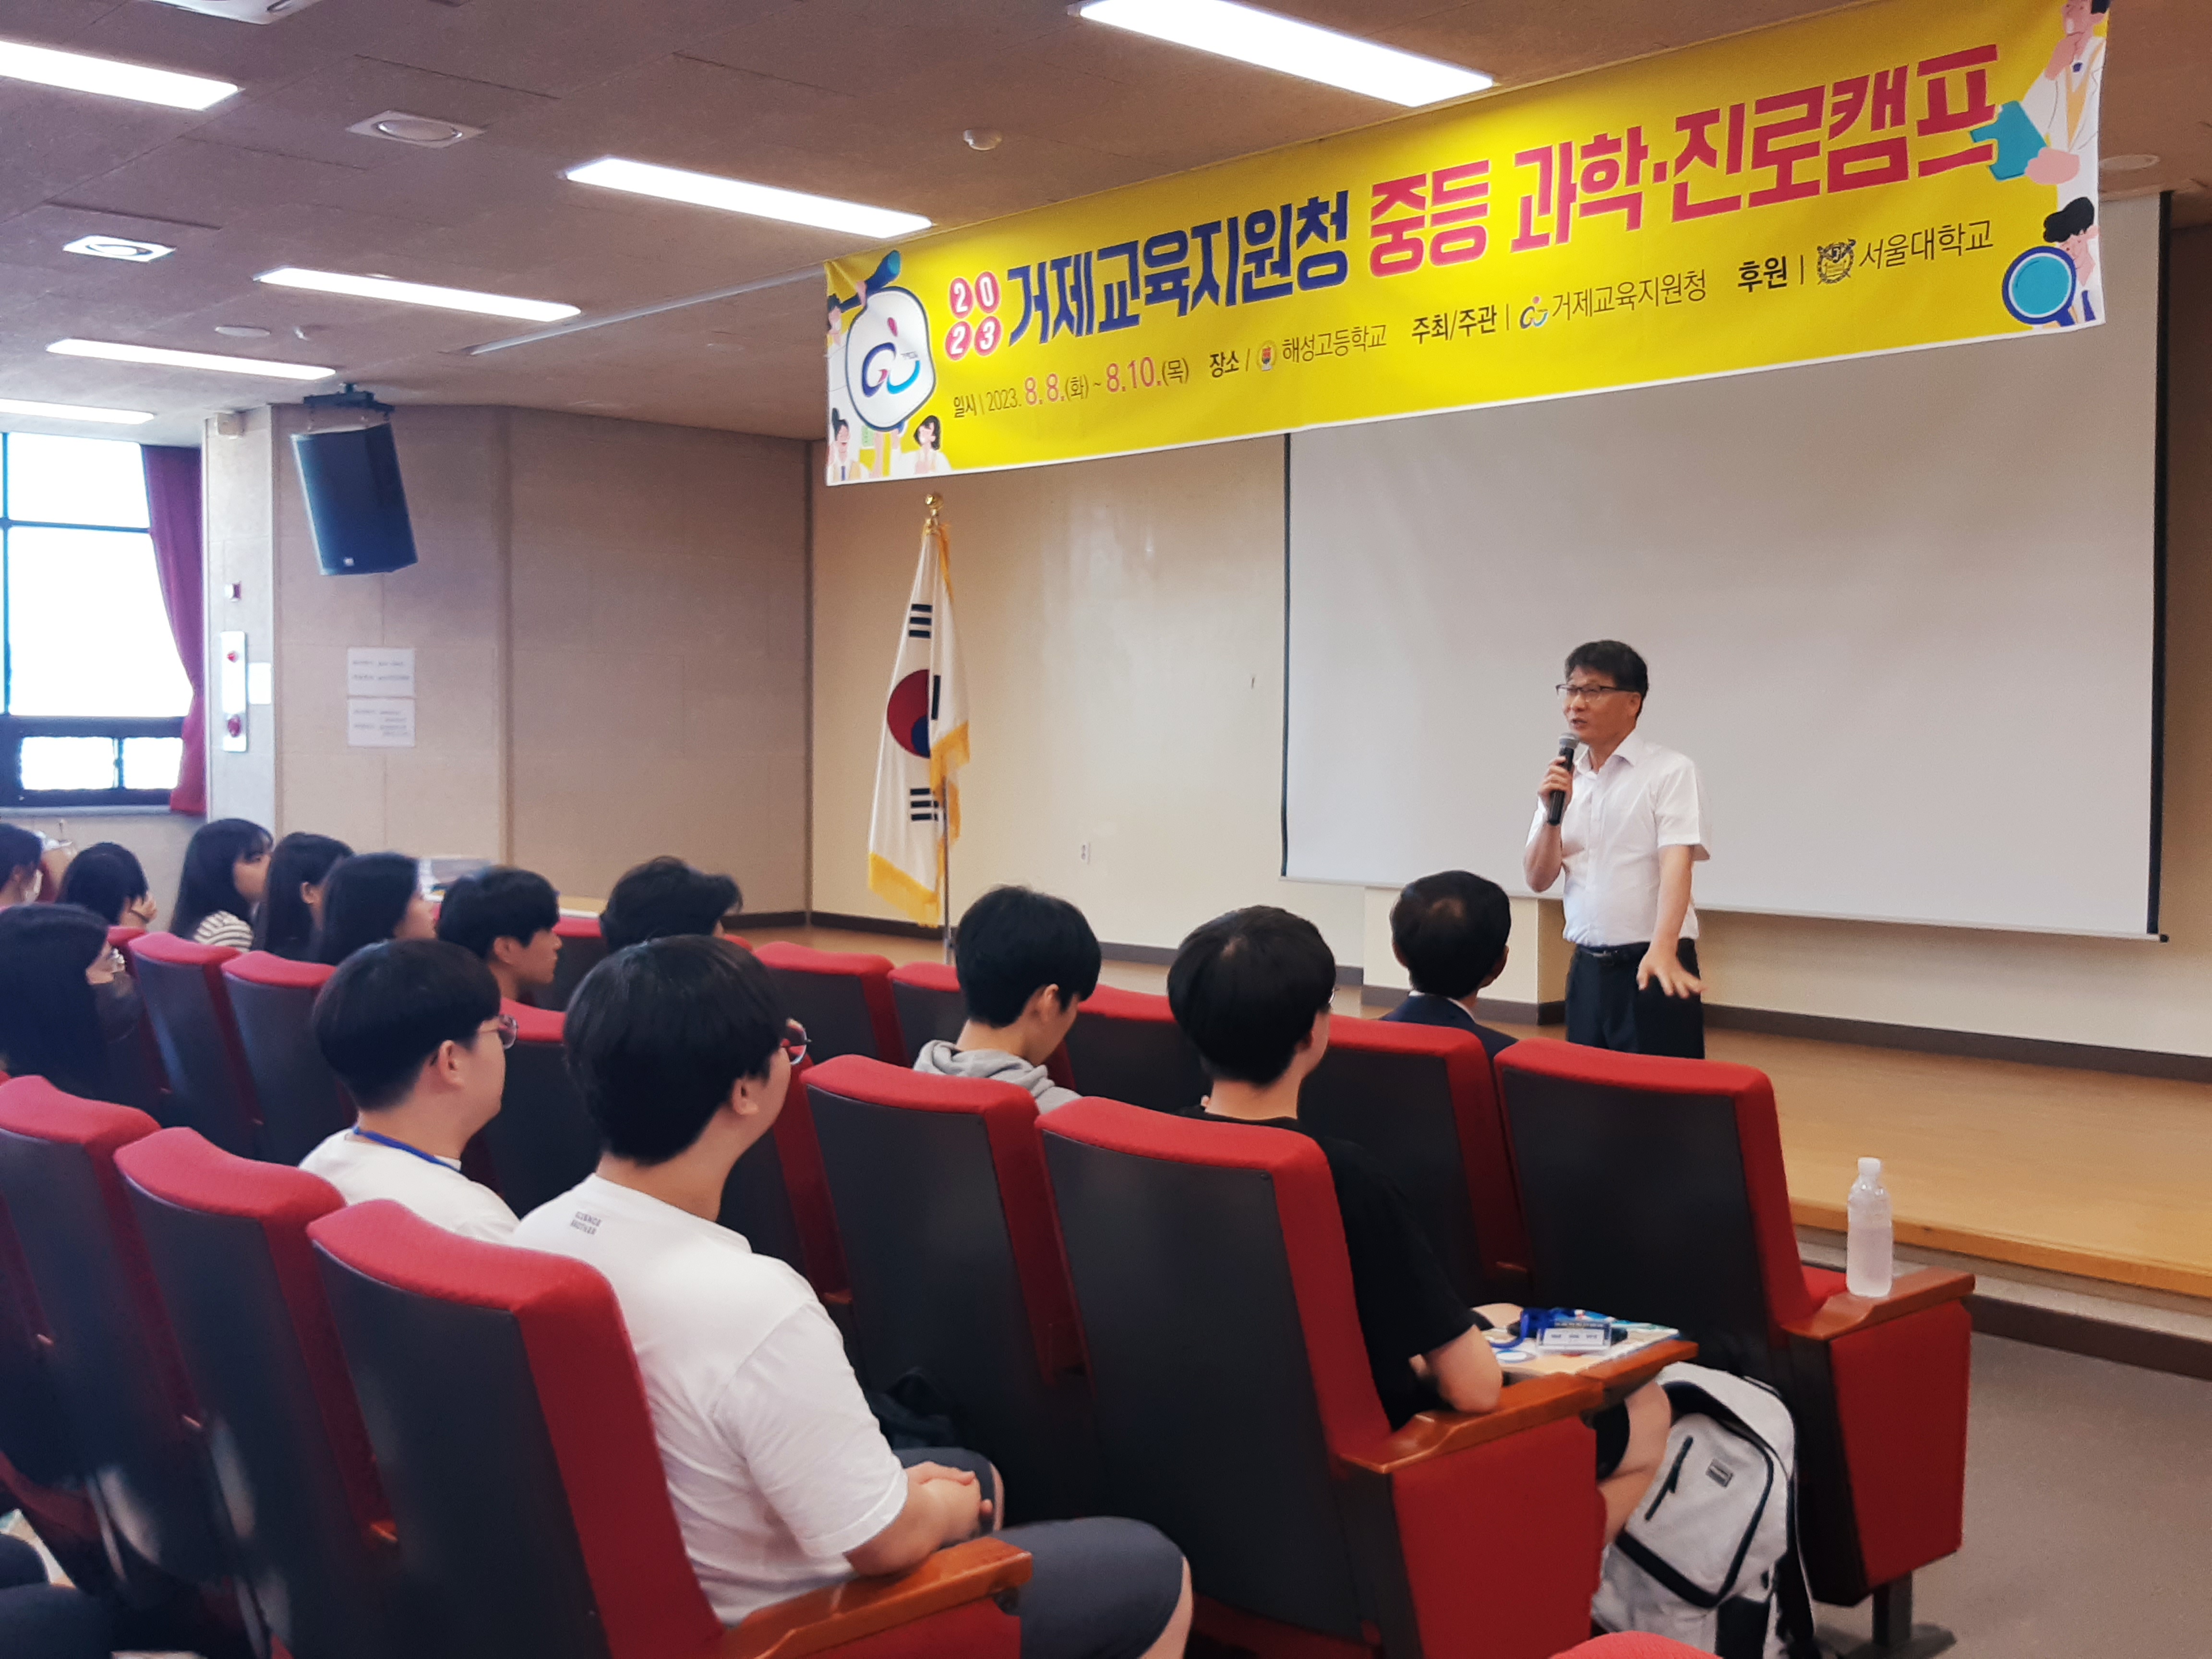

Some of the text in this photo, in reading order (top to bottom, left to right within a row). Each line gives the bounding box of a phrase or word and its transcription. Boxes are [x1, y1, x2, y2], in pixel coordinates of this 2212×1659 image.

[953, 394, 978, 419] 일시
[986, 387, 1022, 412] 2023.
[1209, 350, 1240, 378] 장소
[1282, 325, 1387, 363] 해성고등학교
[1411, 304, 1498, 345] 주최/주관
[1552, 269, 1707, 321] 거제교육지원청
[1737, 255, 1789, 293] 후원
[1858, 220, 1994, 269] 서울대학교
[1007, 191, 1349, 347] 거제교육지원청
[1368, 158, 1491, 277] 중등
